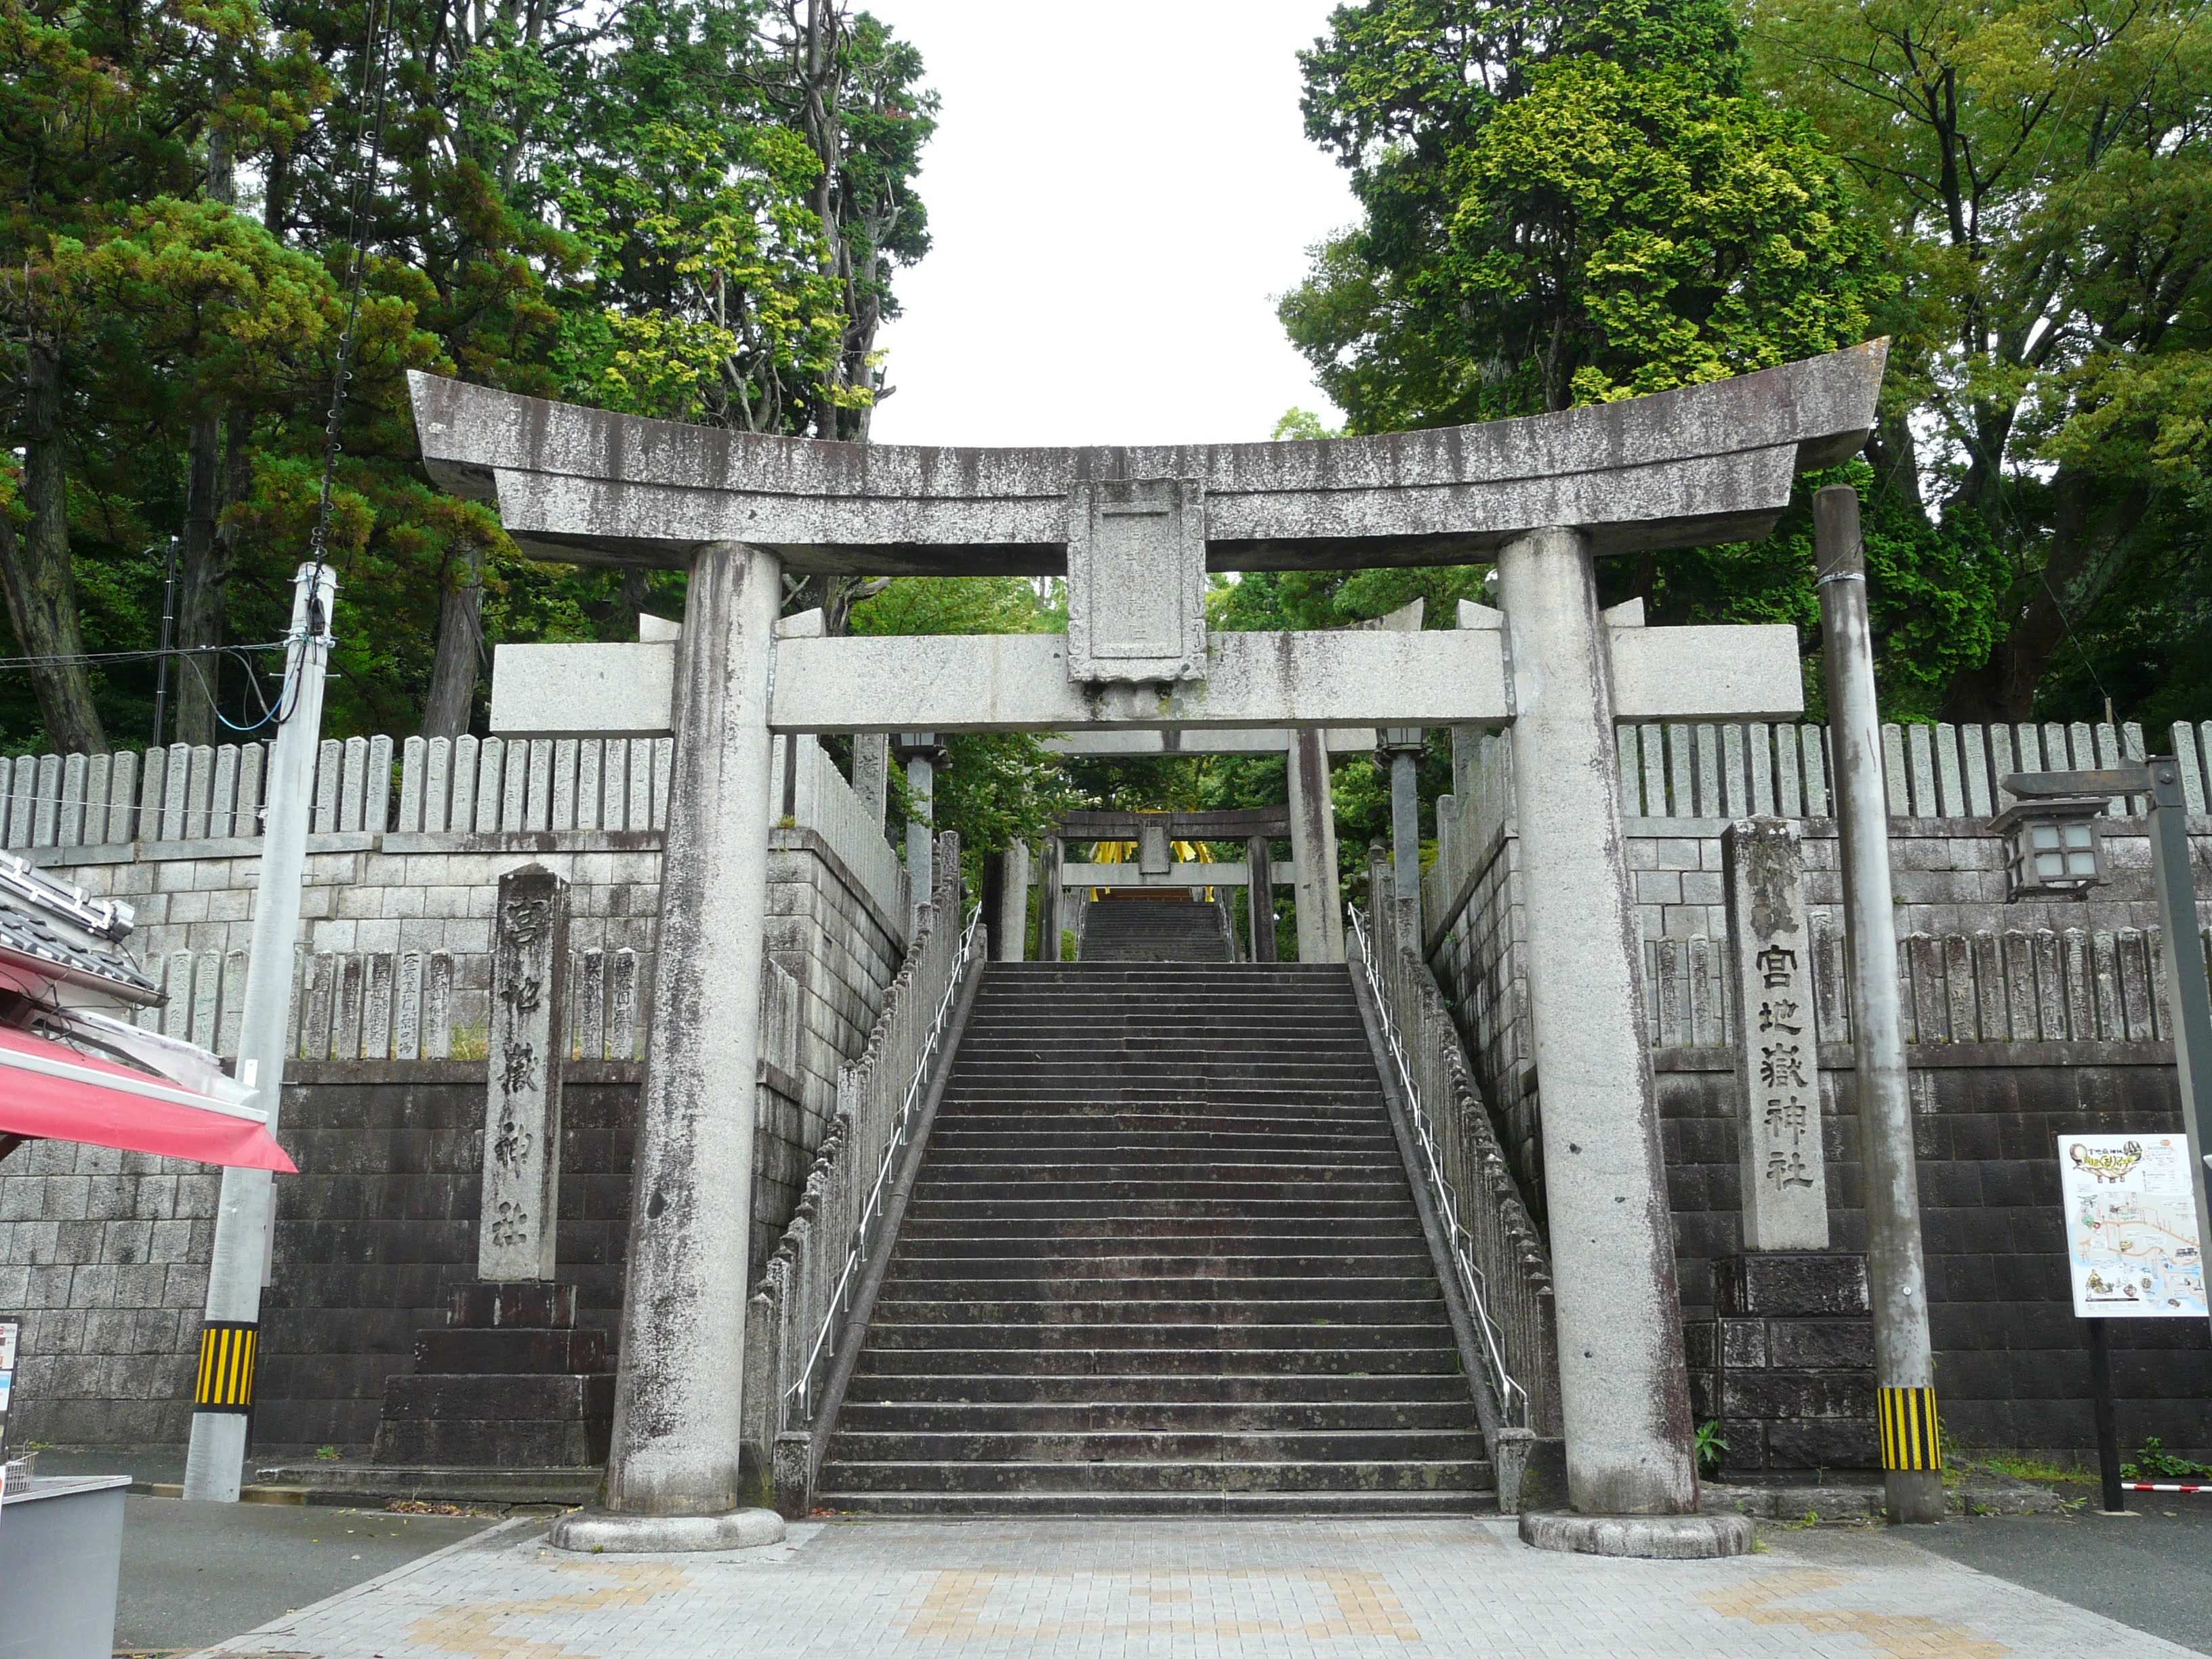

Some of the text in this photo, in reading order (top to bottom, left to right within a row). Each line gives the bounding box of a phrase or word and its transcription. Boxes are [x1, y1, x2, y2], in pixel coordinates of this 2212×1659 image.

[492, 898, 544, 1248] 宮地嶽神社
[1757, 944, 1814, 1191] 宮地嶽神社
